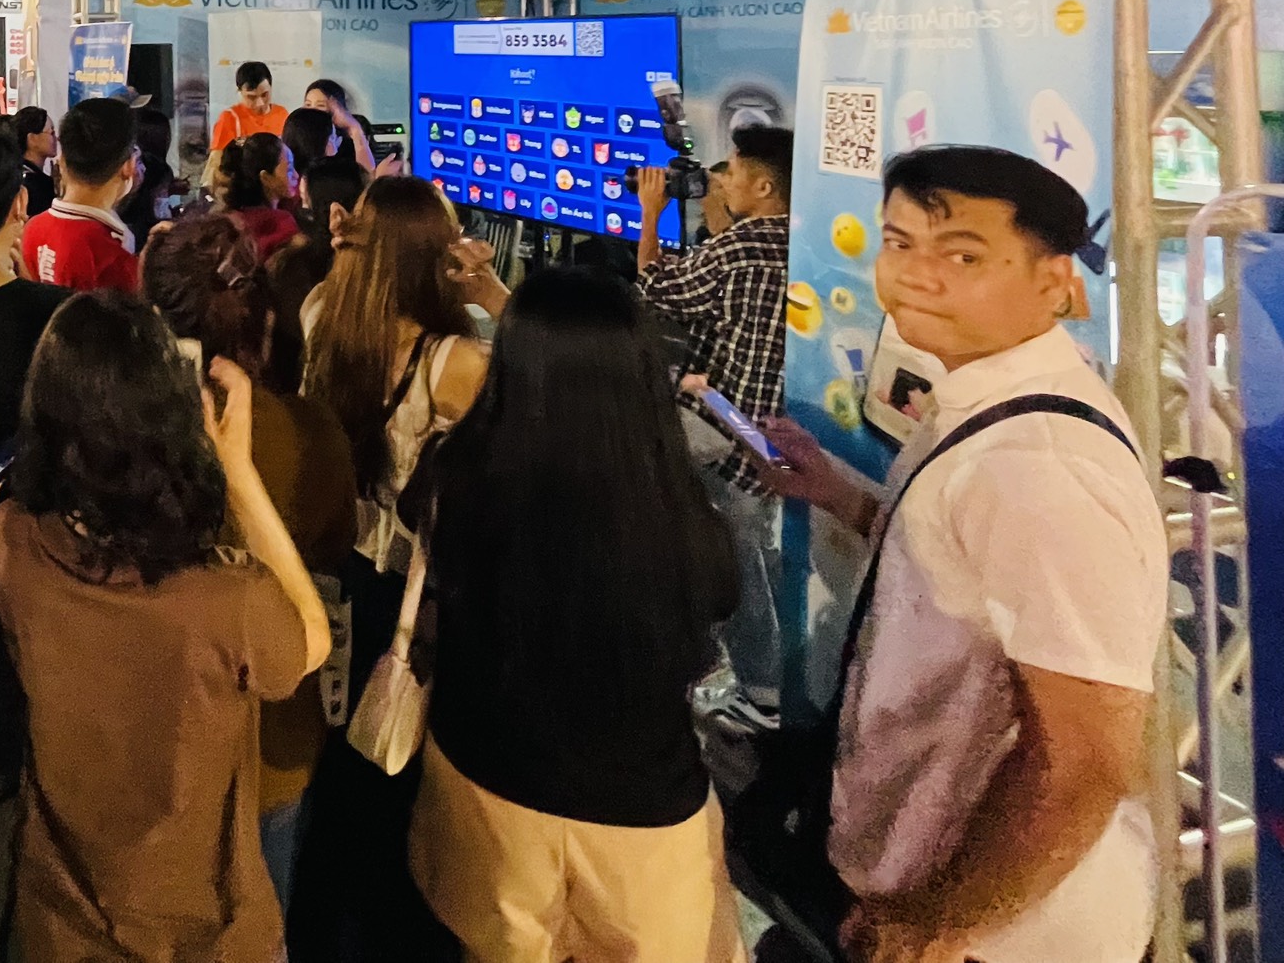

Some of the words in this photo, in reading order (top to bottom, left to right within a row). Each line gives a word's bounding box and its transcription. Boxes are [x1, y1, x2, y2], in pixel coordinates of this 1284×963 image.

[773, 2, 804, 15] CAO
[925, 3, 1003, 30] Airlines
[350, 18, 379, 31] CAO
[505, 35, 529, 47] 859
[532, 34, 567, 48] 3584
